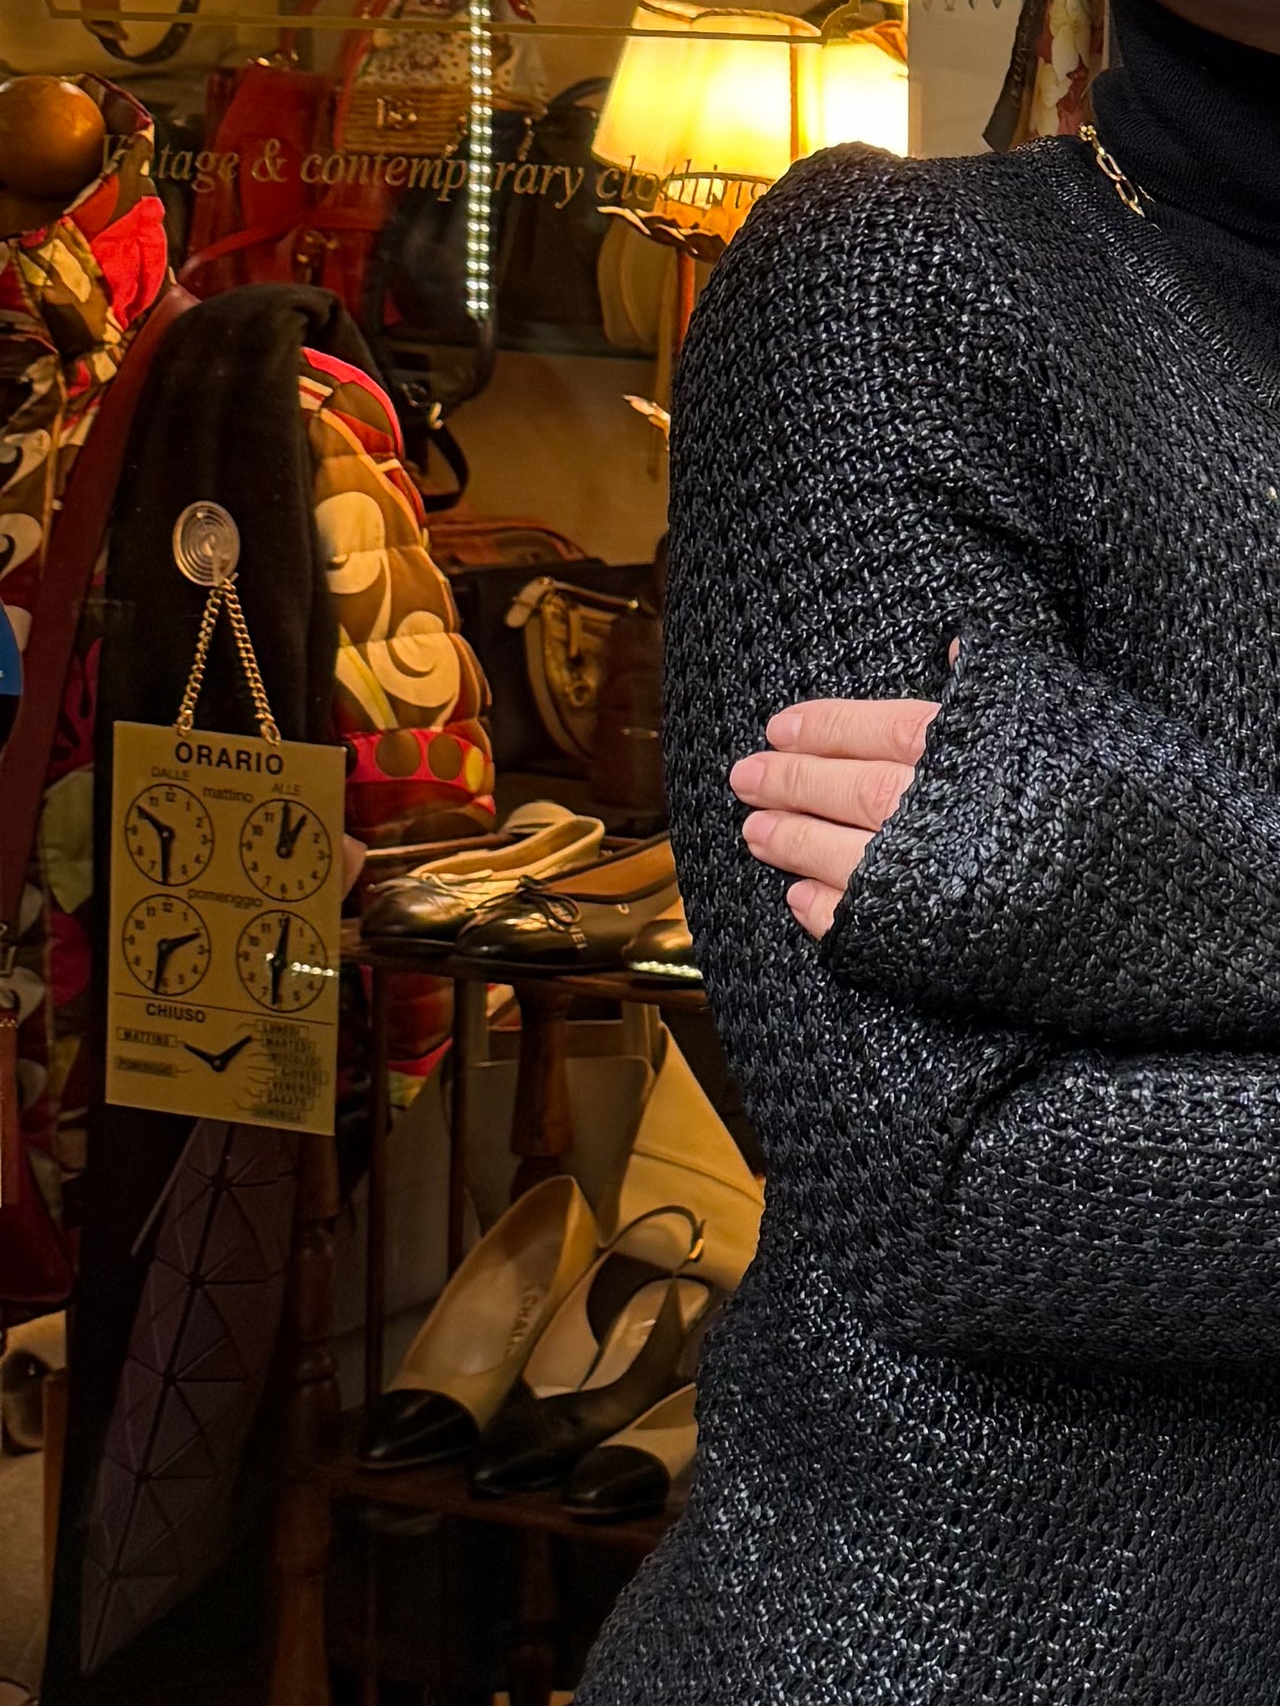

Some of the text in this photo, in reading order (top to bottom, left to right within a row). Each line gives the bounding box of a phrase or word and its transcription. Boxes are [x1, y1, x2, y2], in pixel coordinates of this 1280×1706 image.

[102, 133, 241, 194] Vtage
[250, 138, 289, 183] &
[300, 147, 585, 210] contemprary
[175, 741, 284, 775] ORARIO
[151, 766, 190, 782] DALLE
[202, 786, 254, 804] mattino
[272, 782, 301, 797] ALLE
[146, 1003, 206, 1024] CHIUSO
